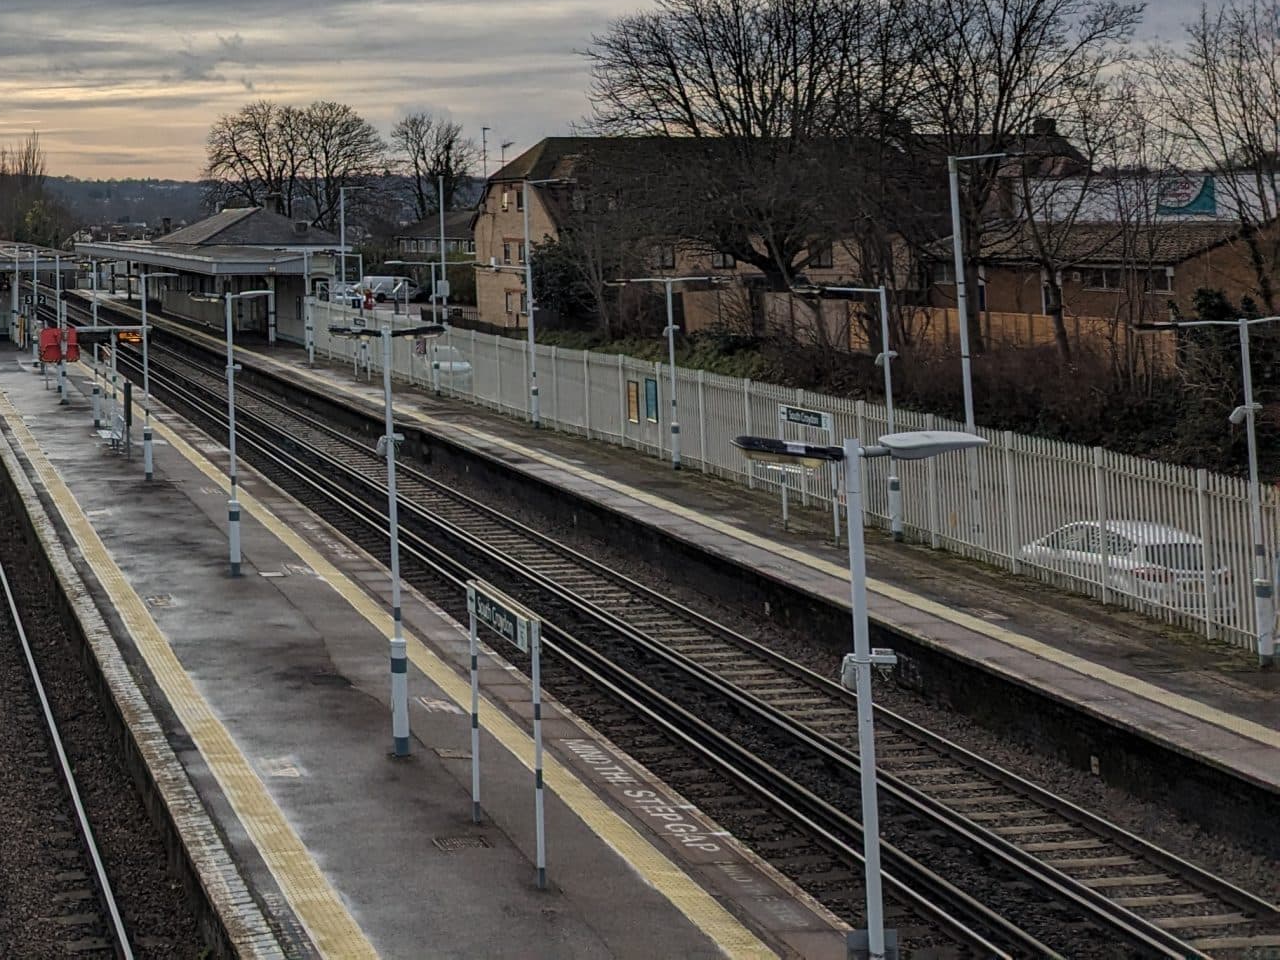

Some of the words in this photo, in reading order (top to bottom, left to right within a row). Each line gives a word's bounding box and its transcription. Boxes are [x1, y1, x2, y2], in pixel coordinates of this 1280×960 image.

[477, 596, 492, 623] South
[491, 606, 514, 640] Croydon
[566, 738, 611, 765] MIND
[594, 766, 644, 787] THE
[623, 788, 684, 823] STEP
[664, 822, 720, 853] GAP
